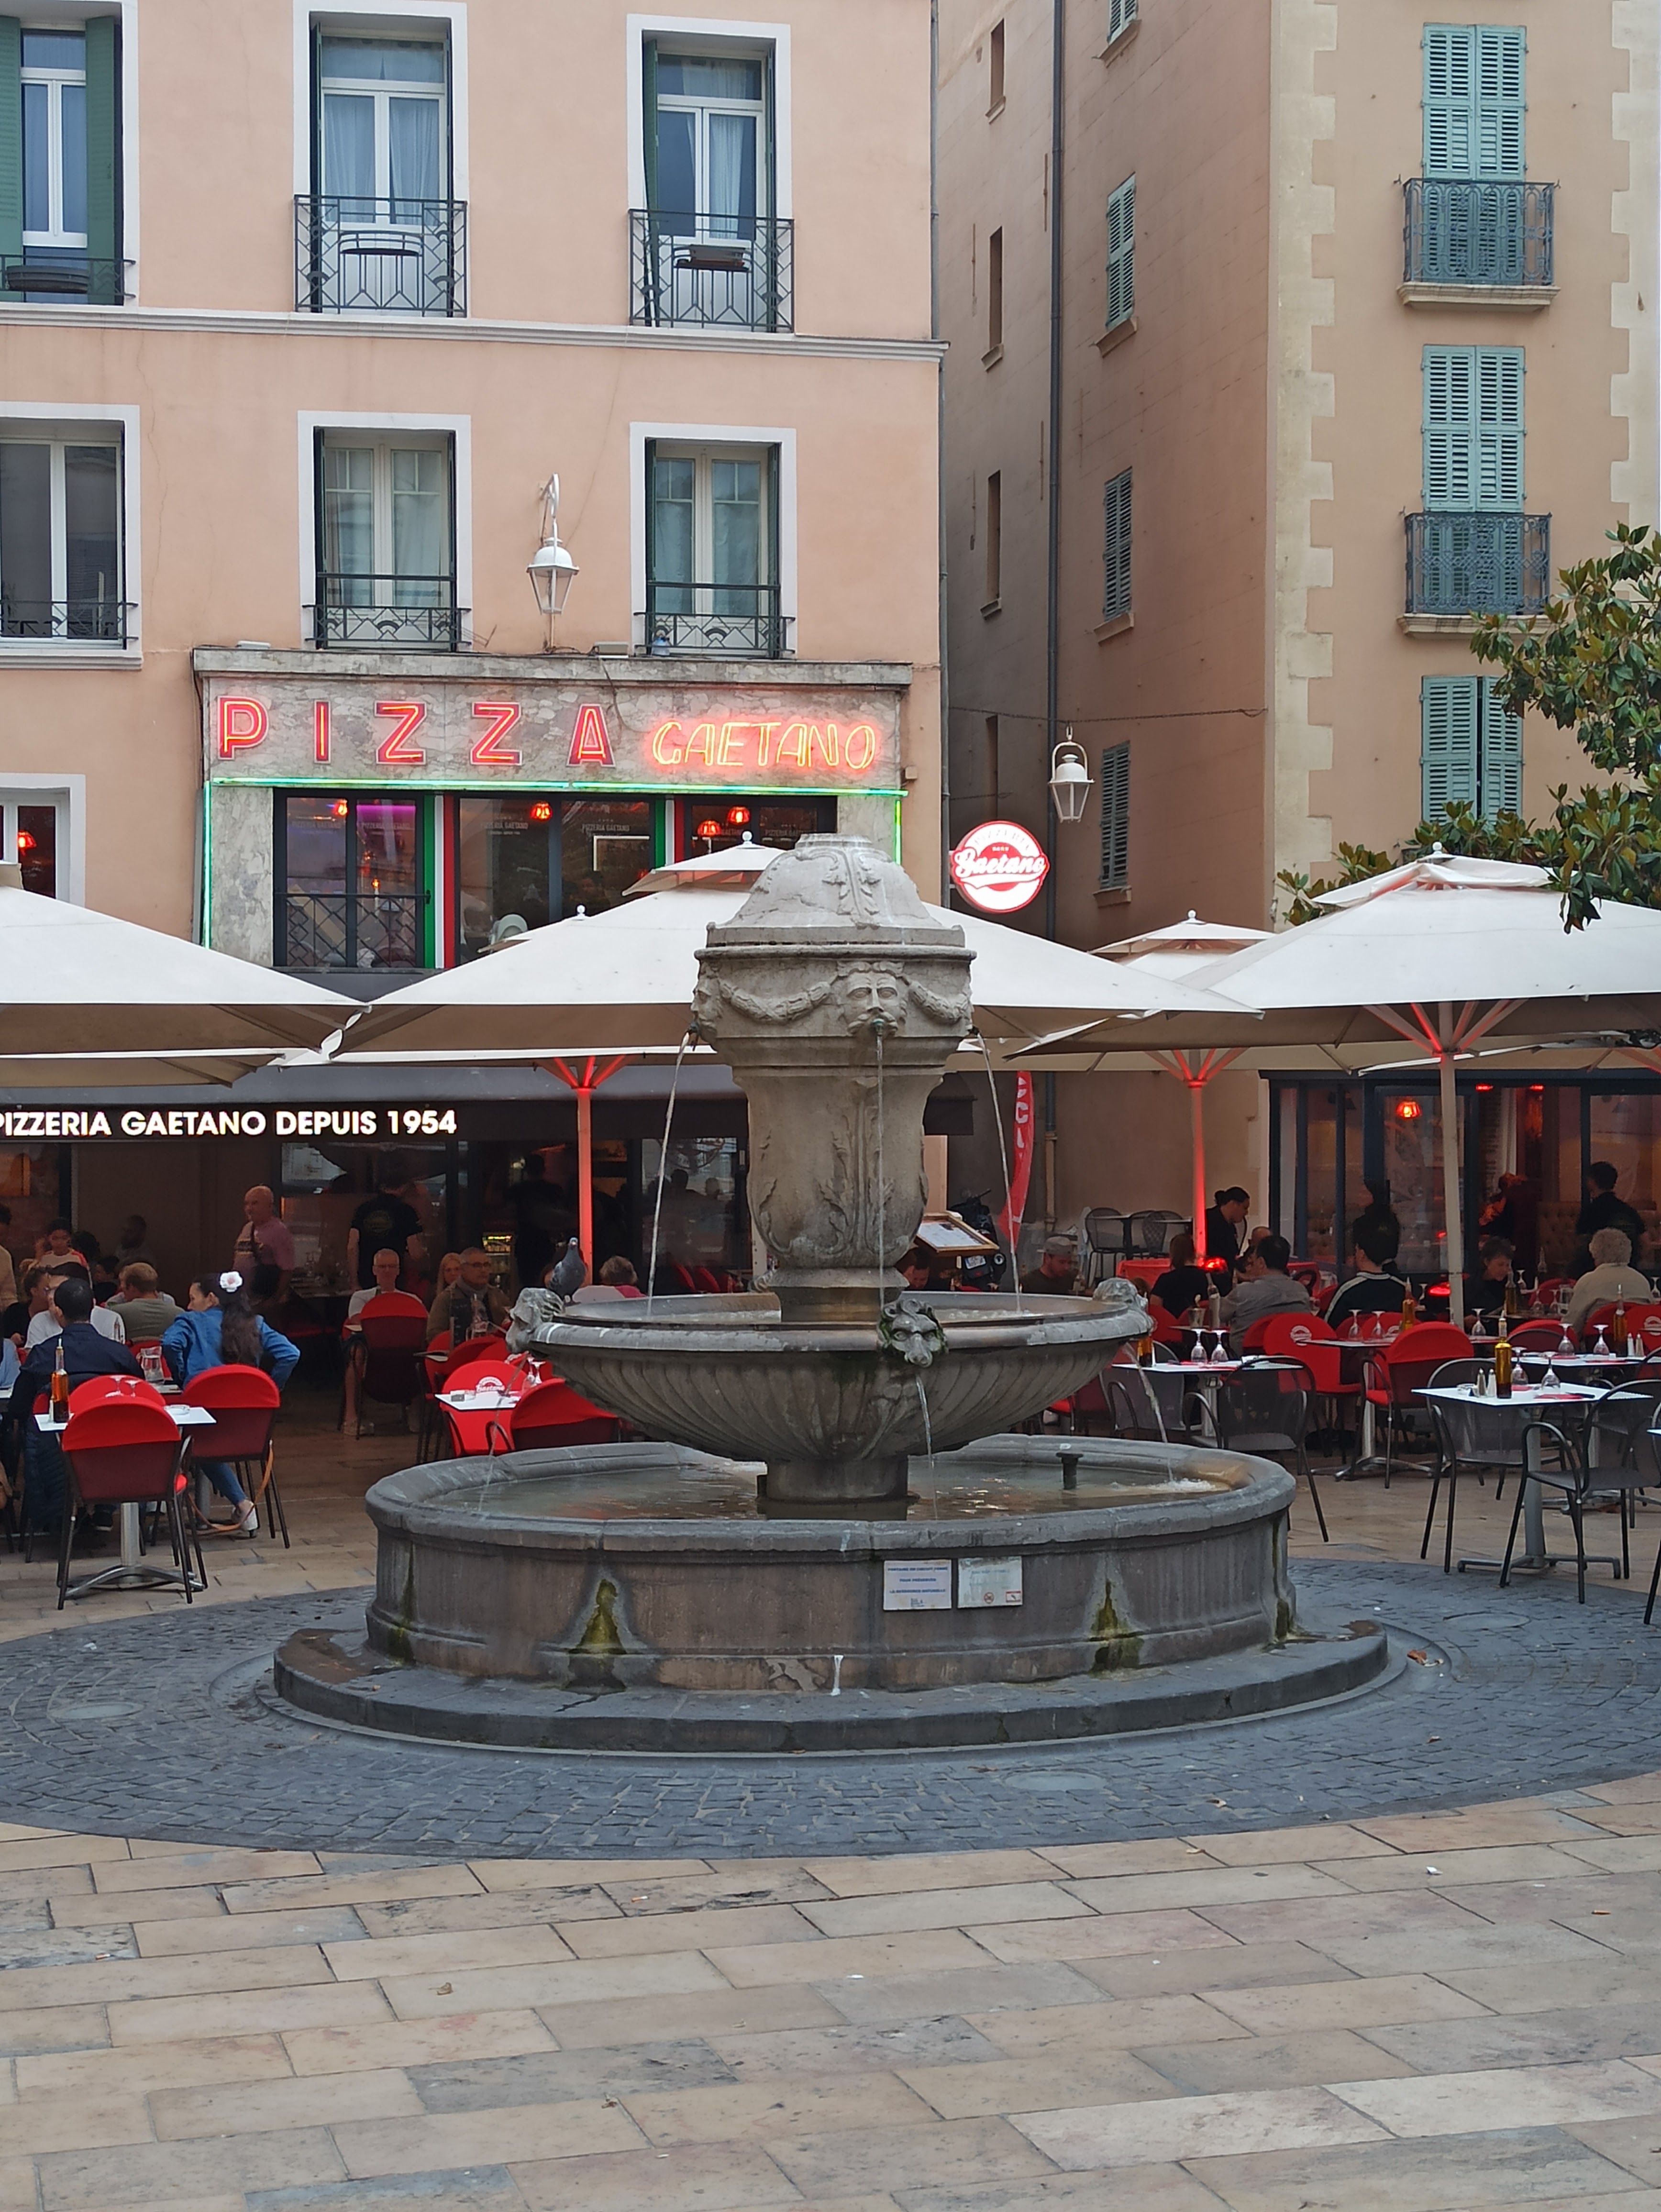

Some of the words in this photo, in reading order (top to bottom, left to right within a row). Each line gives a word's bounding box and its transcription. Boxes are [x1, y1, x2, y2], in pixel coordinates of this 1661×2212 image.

[217, 695, 616, 768] PIZZA
[652, 721, 876, 769] GAETANO
[954, 847, 1045, 878] Gaetano
[121, 1111, 266, 1136] GAETANO
[276, 1110, 376, 1135] DEPUIS
[388, 1109, 457, 1135] 1954
